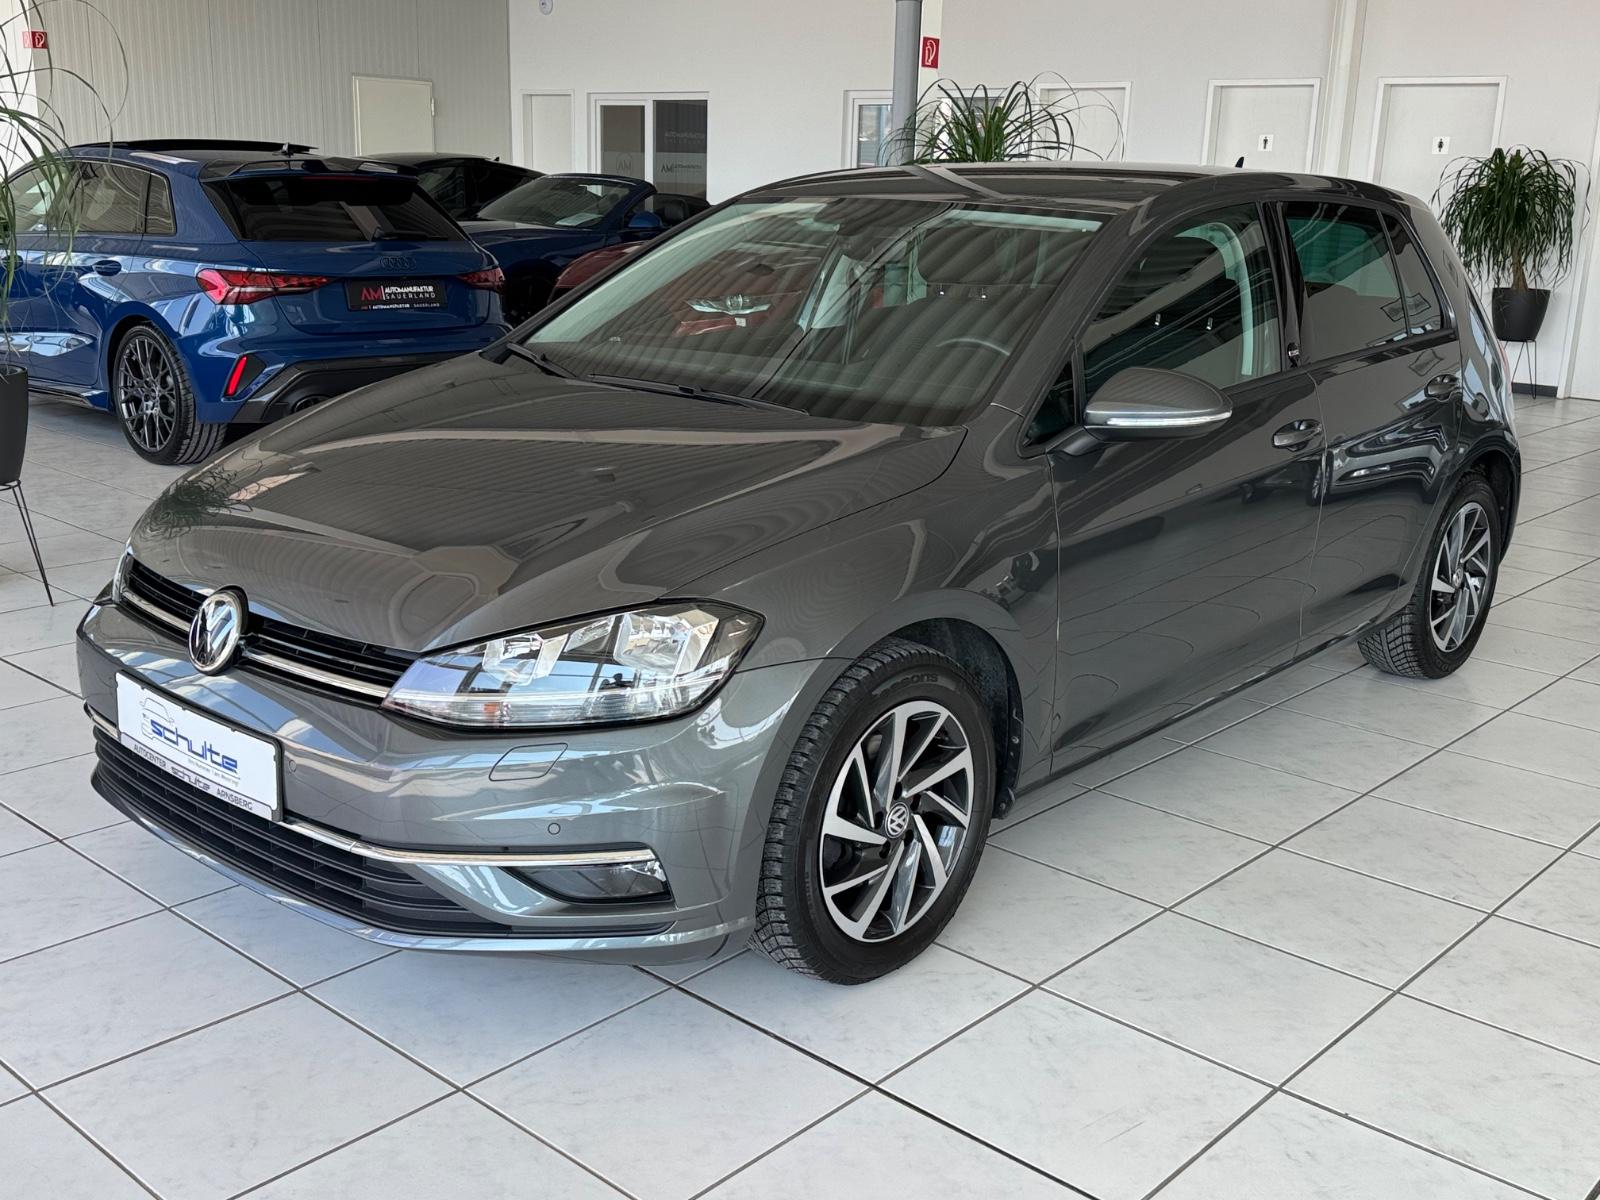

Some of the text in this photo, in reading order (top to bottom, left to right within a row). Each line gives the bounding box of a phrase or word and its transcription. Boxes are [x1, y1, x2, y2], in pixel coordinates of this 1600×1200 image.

[361, 287, 381, 300] AM
[134, 744, 167, 768] AUTOCENTER
[216, 788, 253, 811] ARNSBERG
